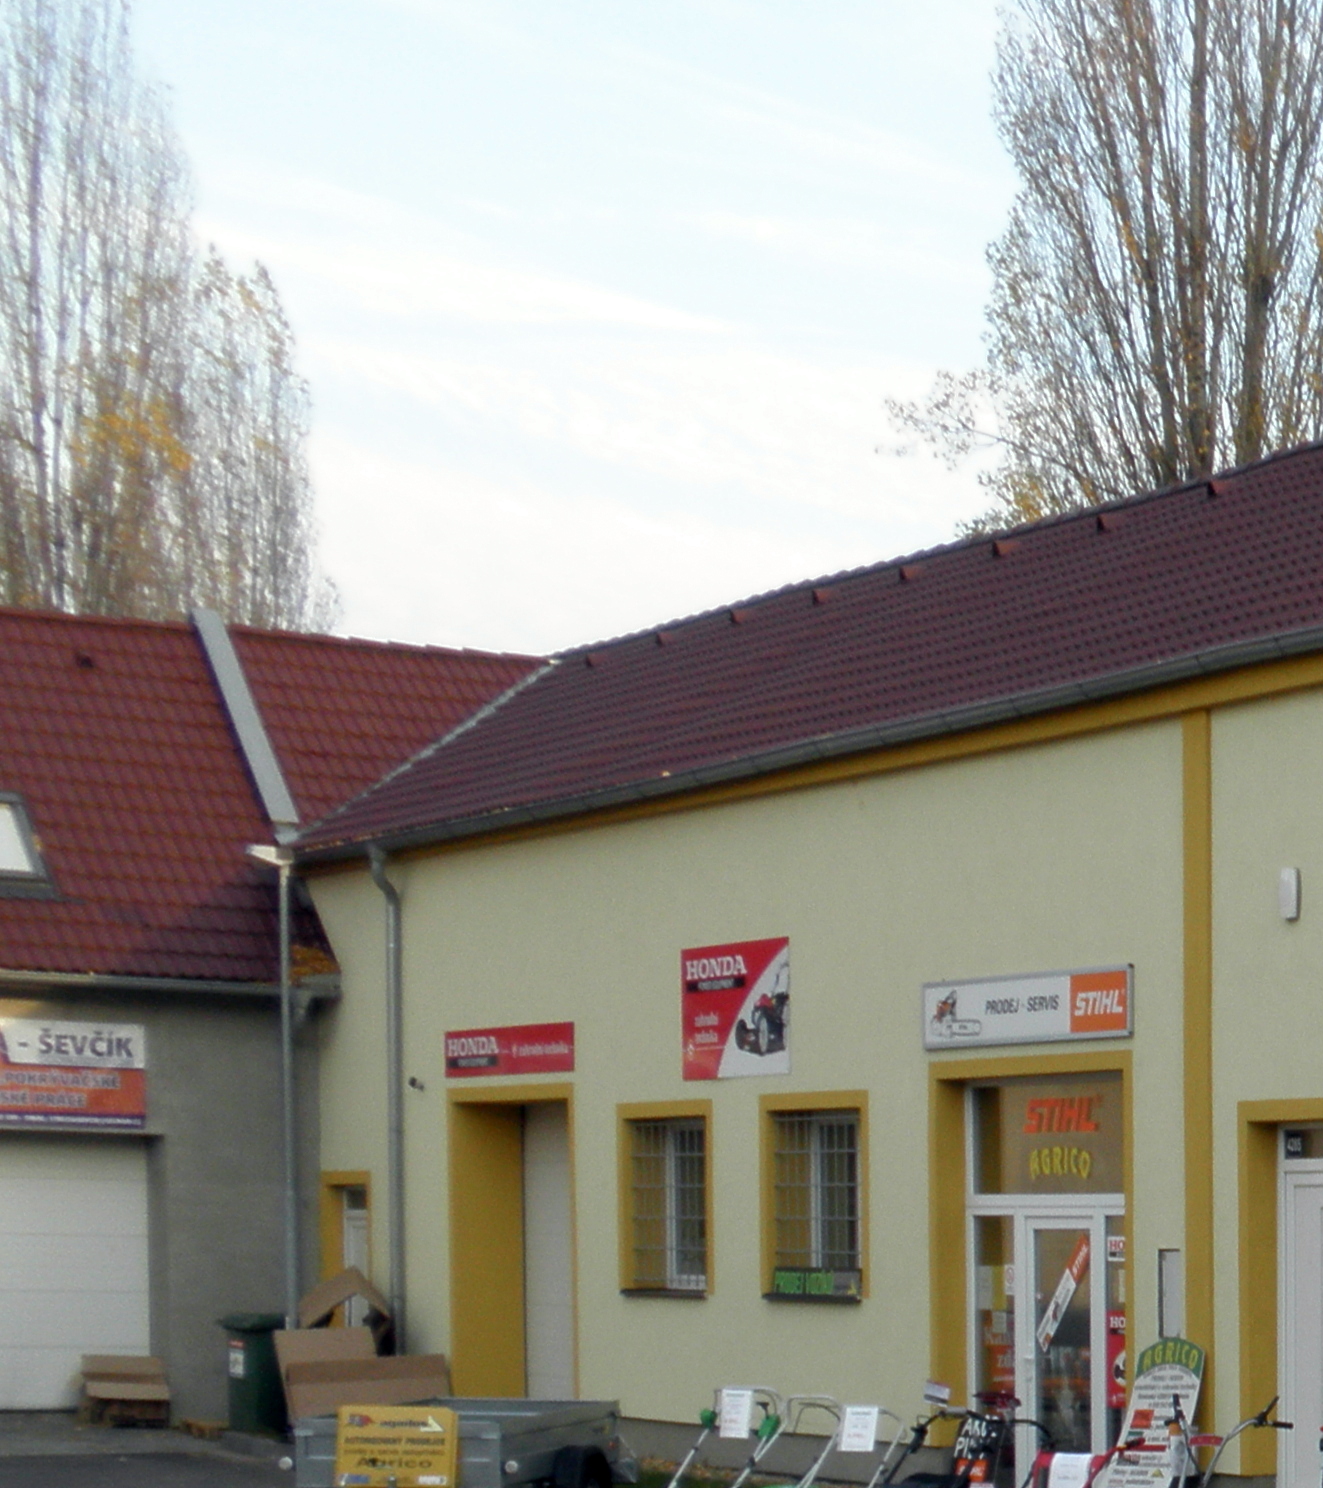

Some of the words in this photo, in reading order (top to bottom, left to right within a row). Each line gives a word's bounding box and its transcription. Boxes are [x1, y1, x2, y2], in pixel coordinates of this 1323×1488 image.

[686, 955, 748, 980] HONDA
[985, 999, 1020, 1015] PRODEJ
[1026, 995, 1060, 1011] SERVIS
[1074, 988, 1124, 1016] STIHL
[38, 1028, 133, 1058] ŠEVČÍK
[448, 1036, 499, 1056] HONDA
[1023, 1097, 1099, 1133] STIHL
[1029, 1147, 1090, 1179] AGRICO
[1143, 1341, 1199, 1372] AGRICO
